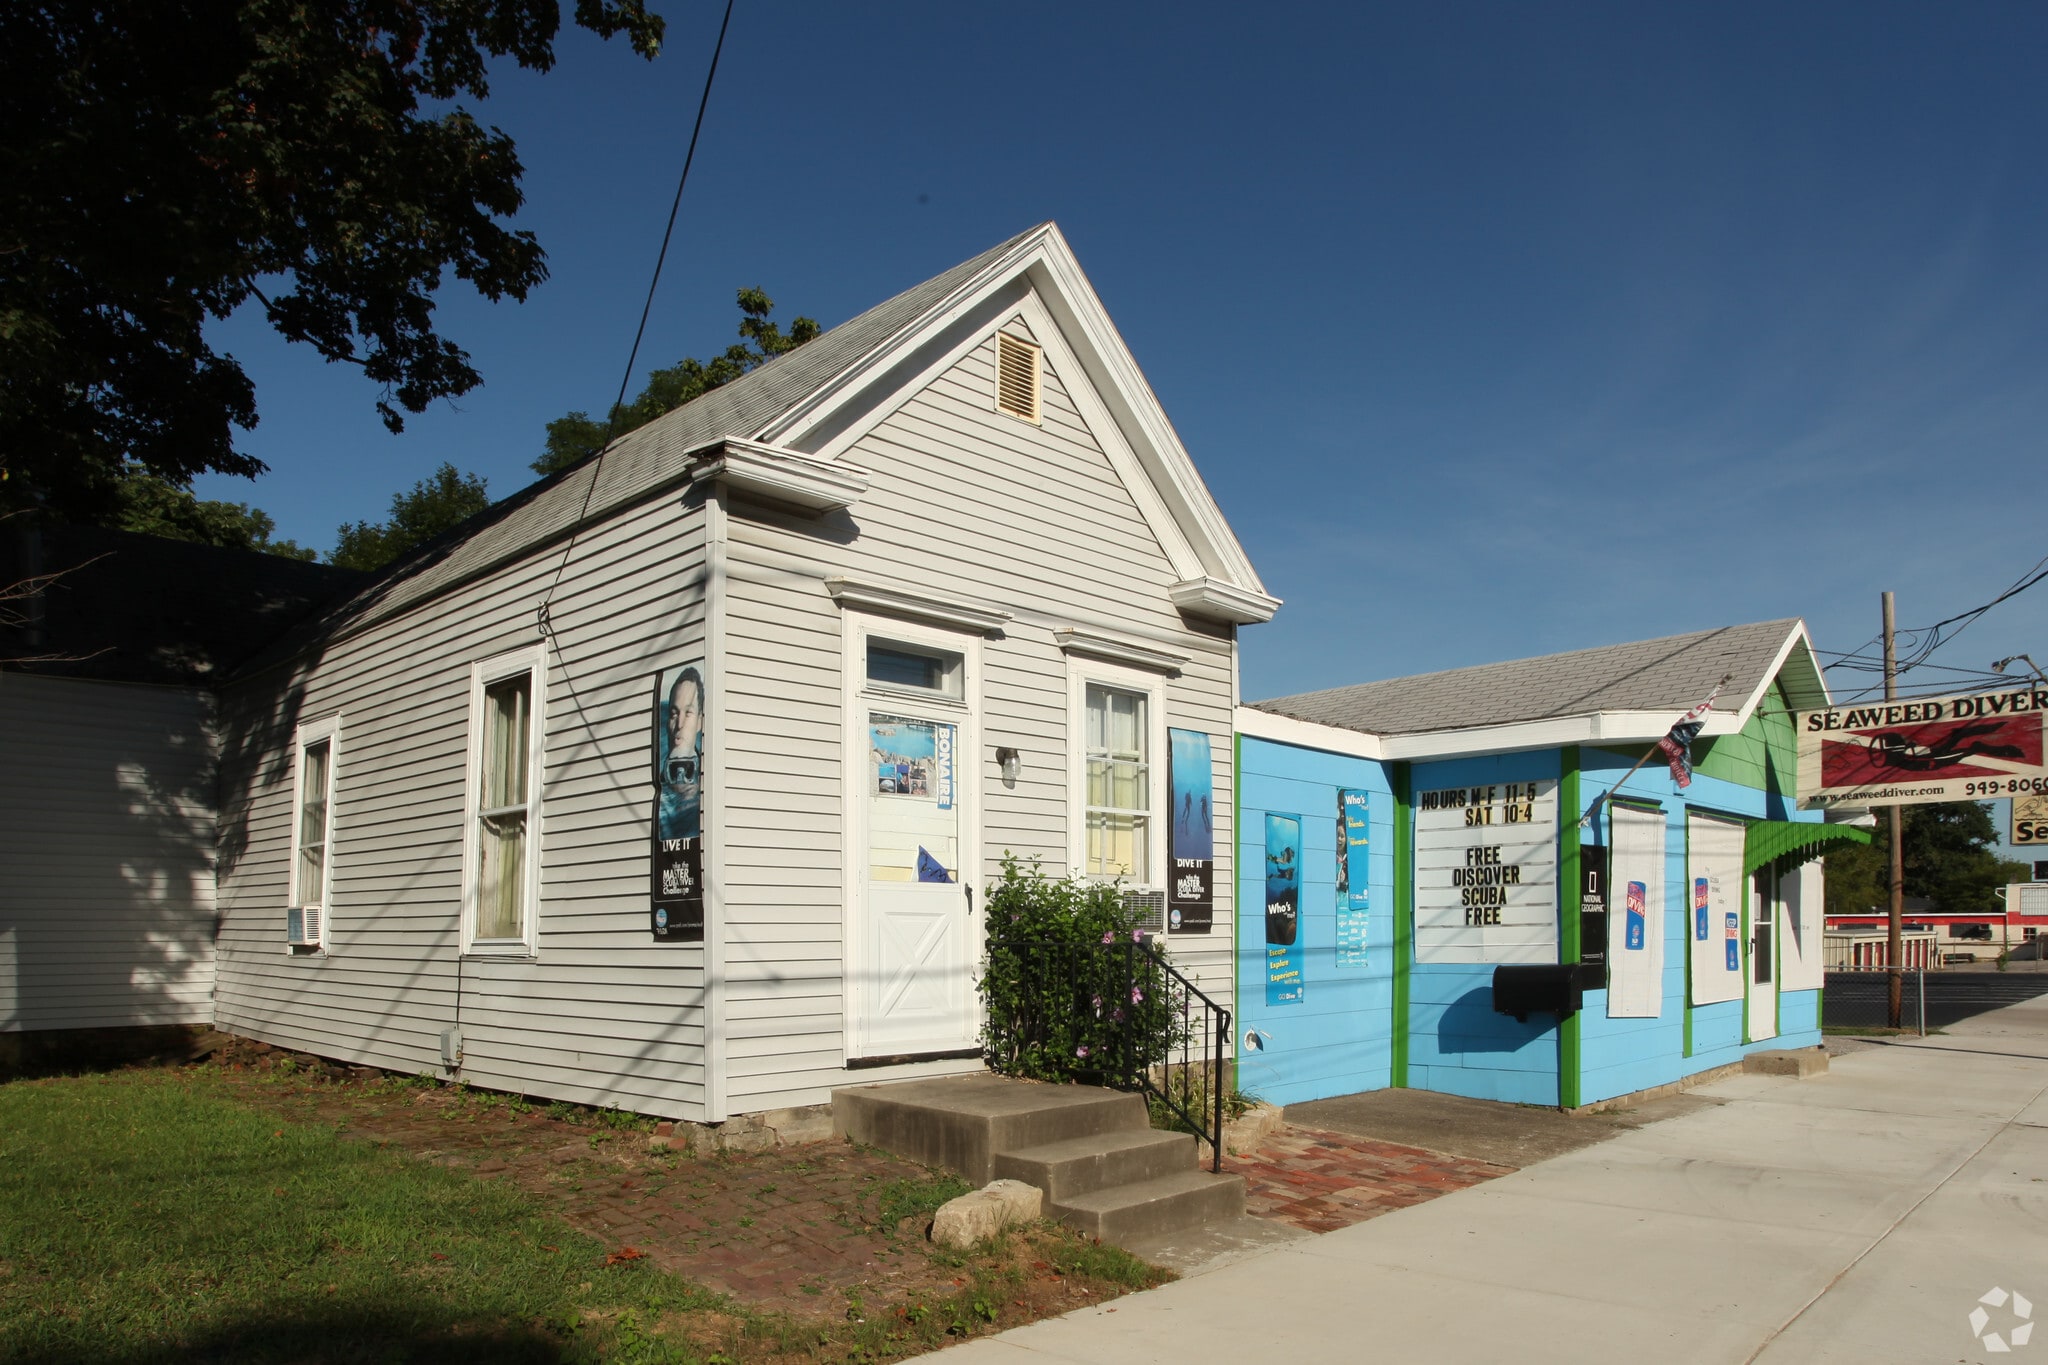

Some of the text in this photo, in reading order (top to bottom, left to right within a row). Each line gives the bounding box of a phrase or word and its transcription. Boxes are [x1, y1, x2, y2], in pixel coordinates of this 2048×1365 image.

[1808, 690, 2048, 732] SEAWEED DIVER
[938, 727, 950, 805] BONAIRE
[1345, 794, 1365, 804] Who's
[1421, 788, 1467, 811] HOURS
[1471, 786, 1496, 806] M-F
[1808, 786, 1944, 802] www.seaweeddiver.com
[1465, 804, 1533, 826] SAT 10-4
[662, 837, 691, 853] LIVE IT
[1177, 858, 1203, 868] DIVE IT
[1466, 846, 1501, 866] FREE
[663, 868, 689, 881] MASTER
[1453, 865, 1520, 886] DISCOVER
[1177, 879, 1200, 888] MASTER
[1462, 886, 1507, 906] SCUBA
[1268, 901, 1291, 915] Who's
[1465, 907, 1502, 926] FREE
[1269, 948, 1287, 957] Escape
[1270, 960, 1289, 969] Explore
[1270, 970, 1299, 982] Experience
